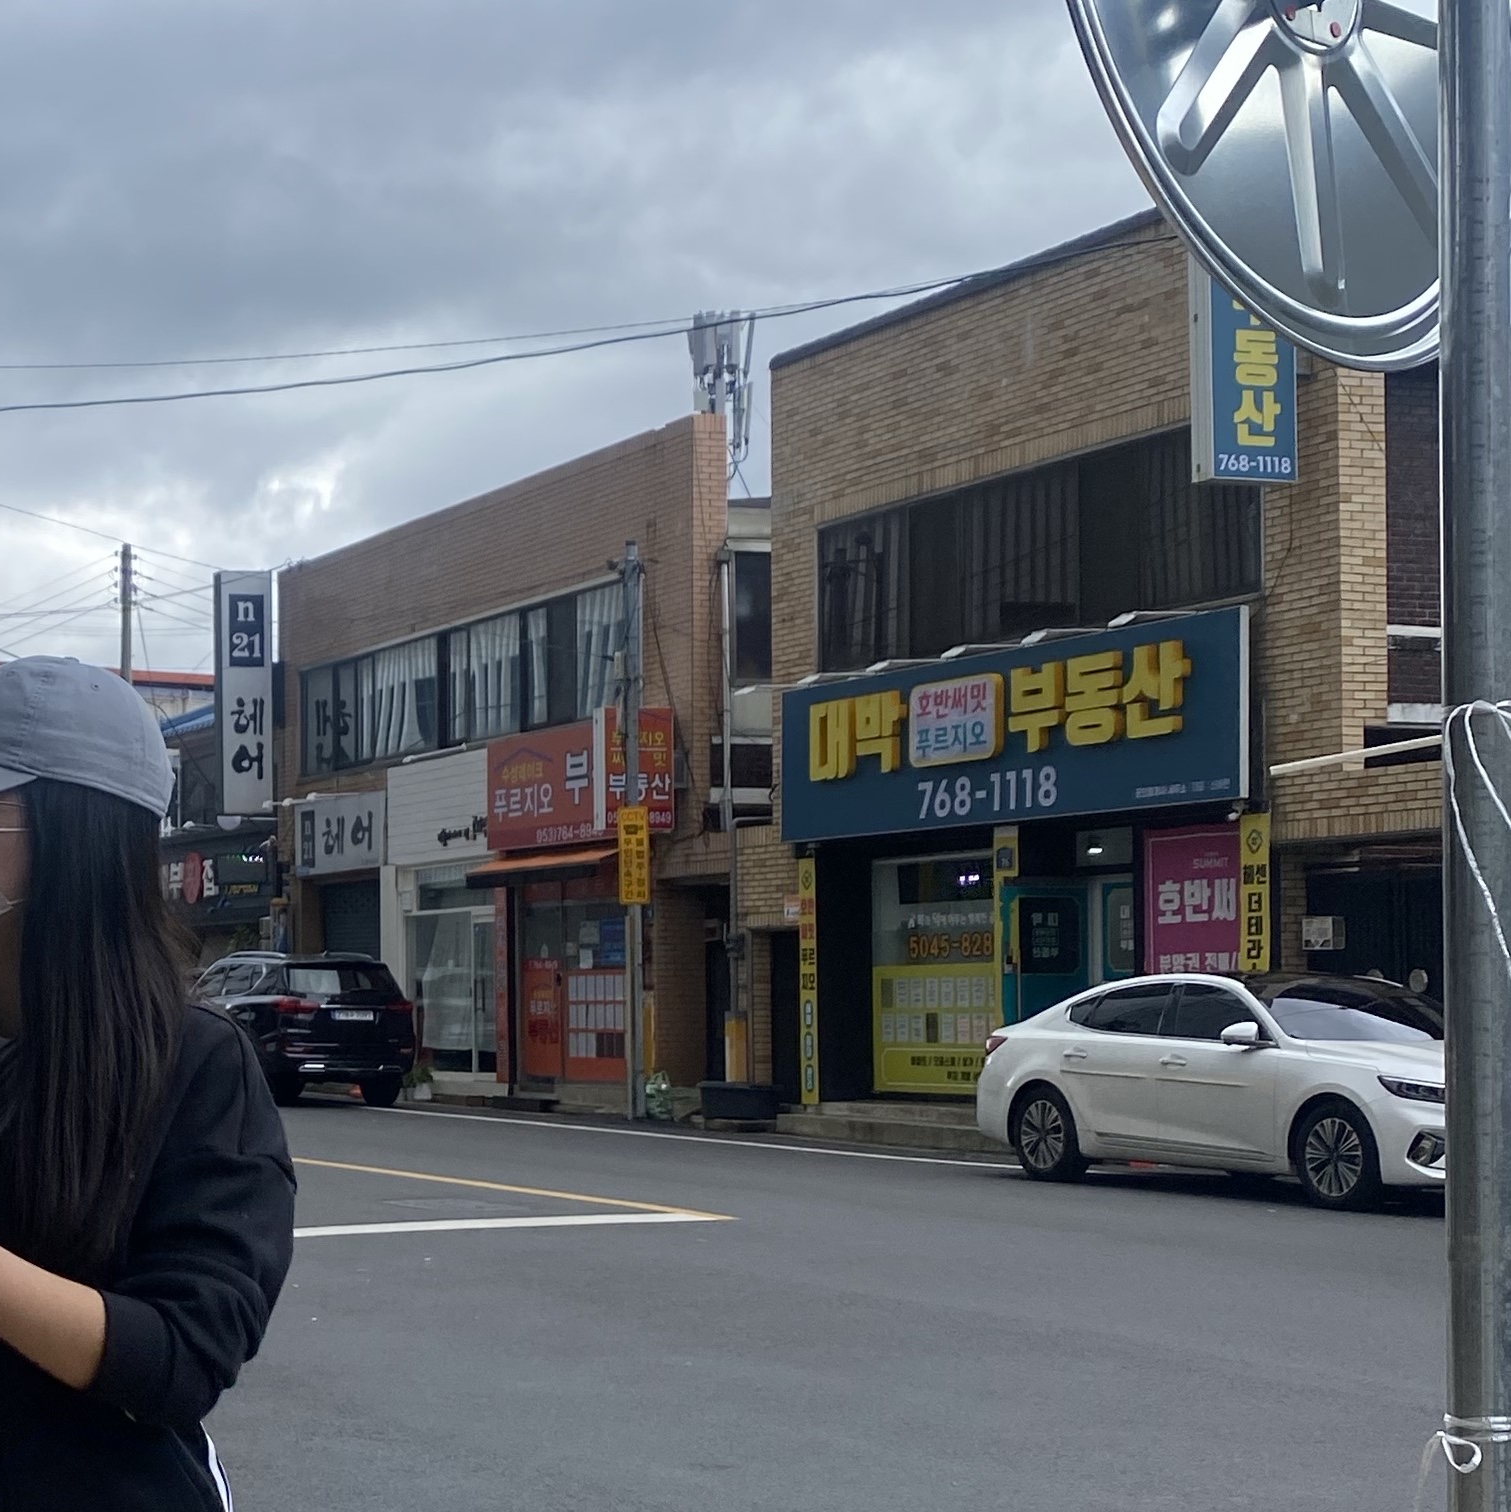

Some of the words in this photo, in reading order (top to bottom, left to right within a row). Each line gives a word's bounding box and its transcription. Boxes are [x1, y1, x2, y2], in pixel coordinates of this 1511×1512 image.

[1232, 300, 1282, 447] 동산
[1218, 454, 1292, 474] 768-1118
[237, 599, 256, 622] n
[231, 631, 262, 658] 21
[809, 690, 907, 782] 대박
[1008, 640, 1192, 753] 부동산
[916, 681, 988, 719] 호반써밋
[230, 696, 265, 780] 헤어
[916, 720, 988, 758] 푸르지오
[565, 750, 593, 805] 부
[917, 765, 1058, 820] 768-1118
[494, 783, 554, 823] 푸르지오
[621, 810, 645, 823] CCTV
[322, 810, 374, 856] 헤어
[1192, 856, 1230, 869] SUMMIT
[1157, 877, 1237, 925] 호반써
[1246, 891, 1264, 970] 더테라
